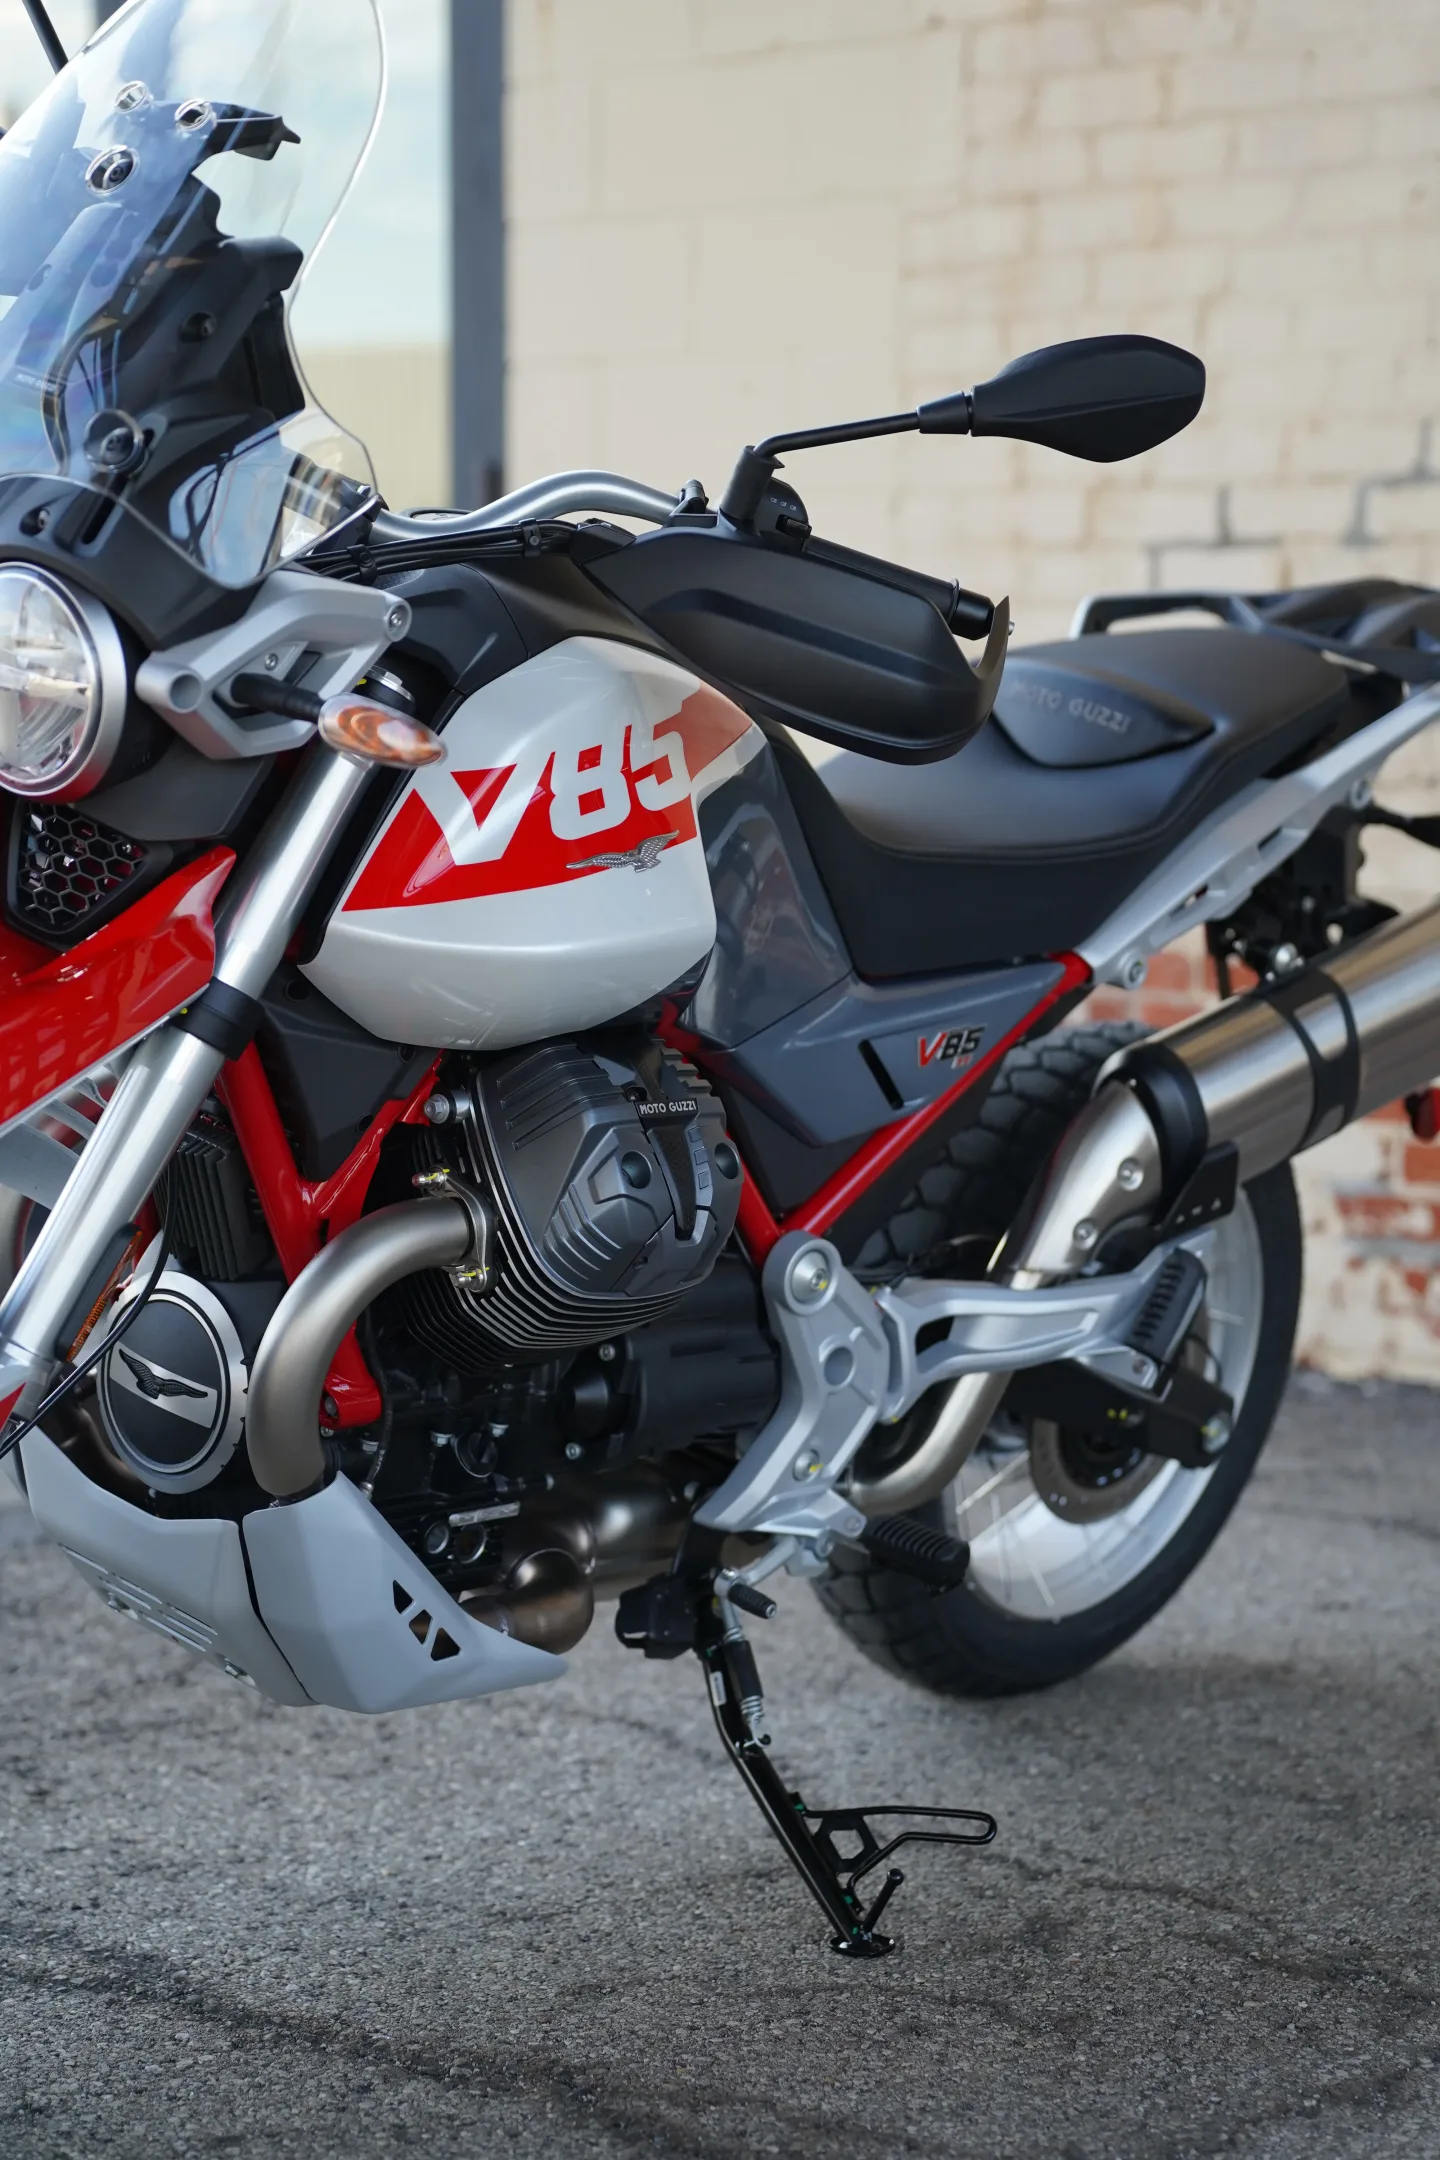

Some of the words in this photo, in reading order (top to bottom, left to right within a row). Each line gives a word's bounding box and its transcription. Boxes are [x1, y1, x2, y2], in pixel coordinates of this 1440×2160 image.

[1068, 697, 1132, 734] GUZZI
[412, 702, 693, 866] V85
[918, 1026, 985, 1067] V85
[640, 1102, 667, 1115] MOTO
[668, 1100, 697, 1112] GUZZI
